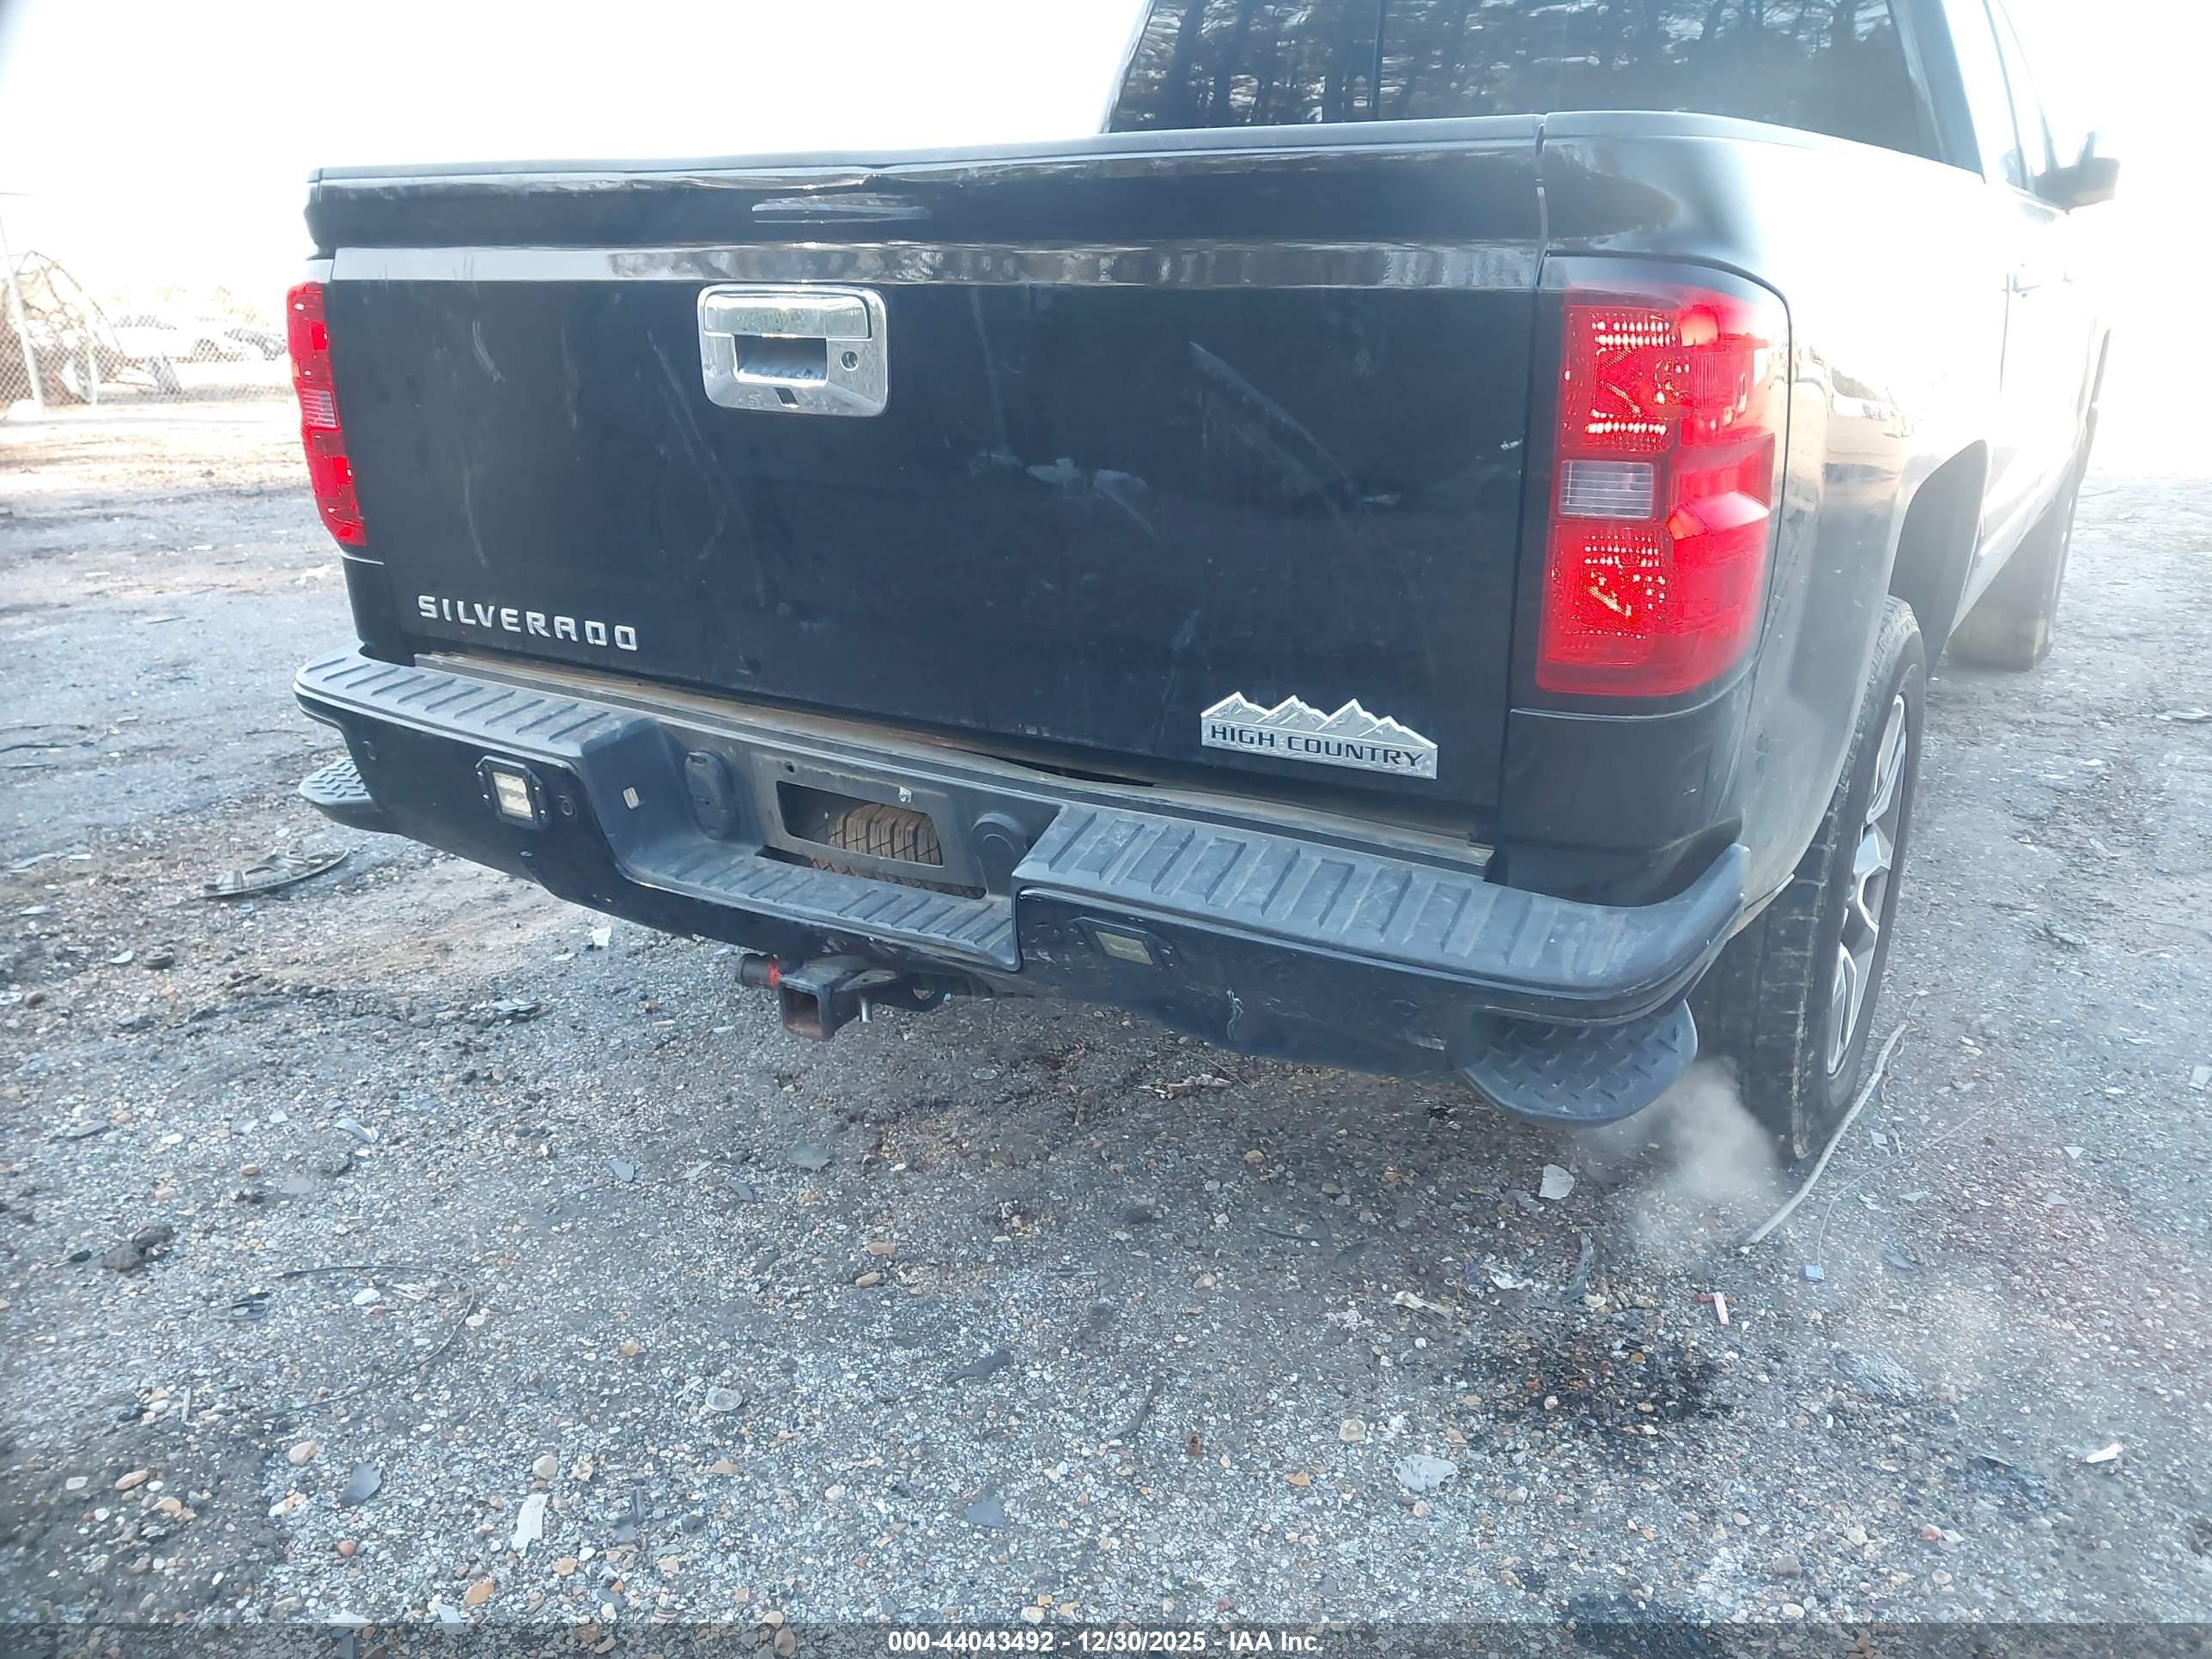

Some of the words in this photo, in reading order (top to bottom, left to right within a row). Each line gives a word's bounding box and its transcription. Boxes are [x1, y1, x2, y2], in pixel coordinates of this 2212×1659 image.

[417, 594, 638, 651] SILVERADO
[1211, 725, 1275, 747] HIGH
[1287, 736, 1425, 767] COUNTRY
